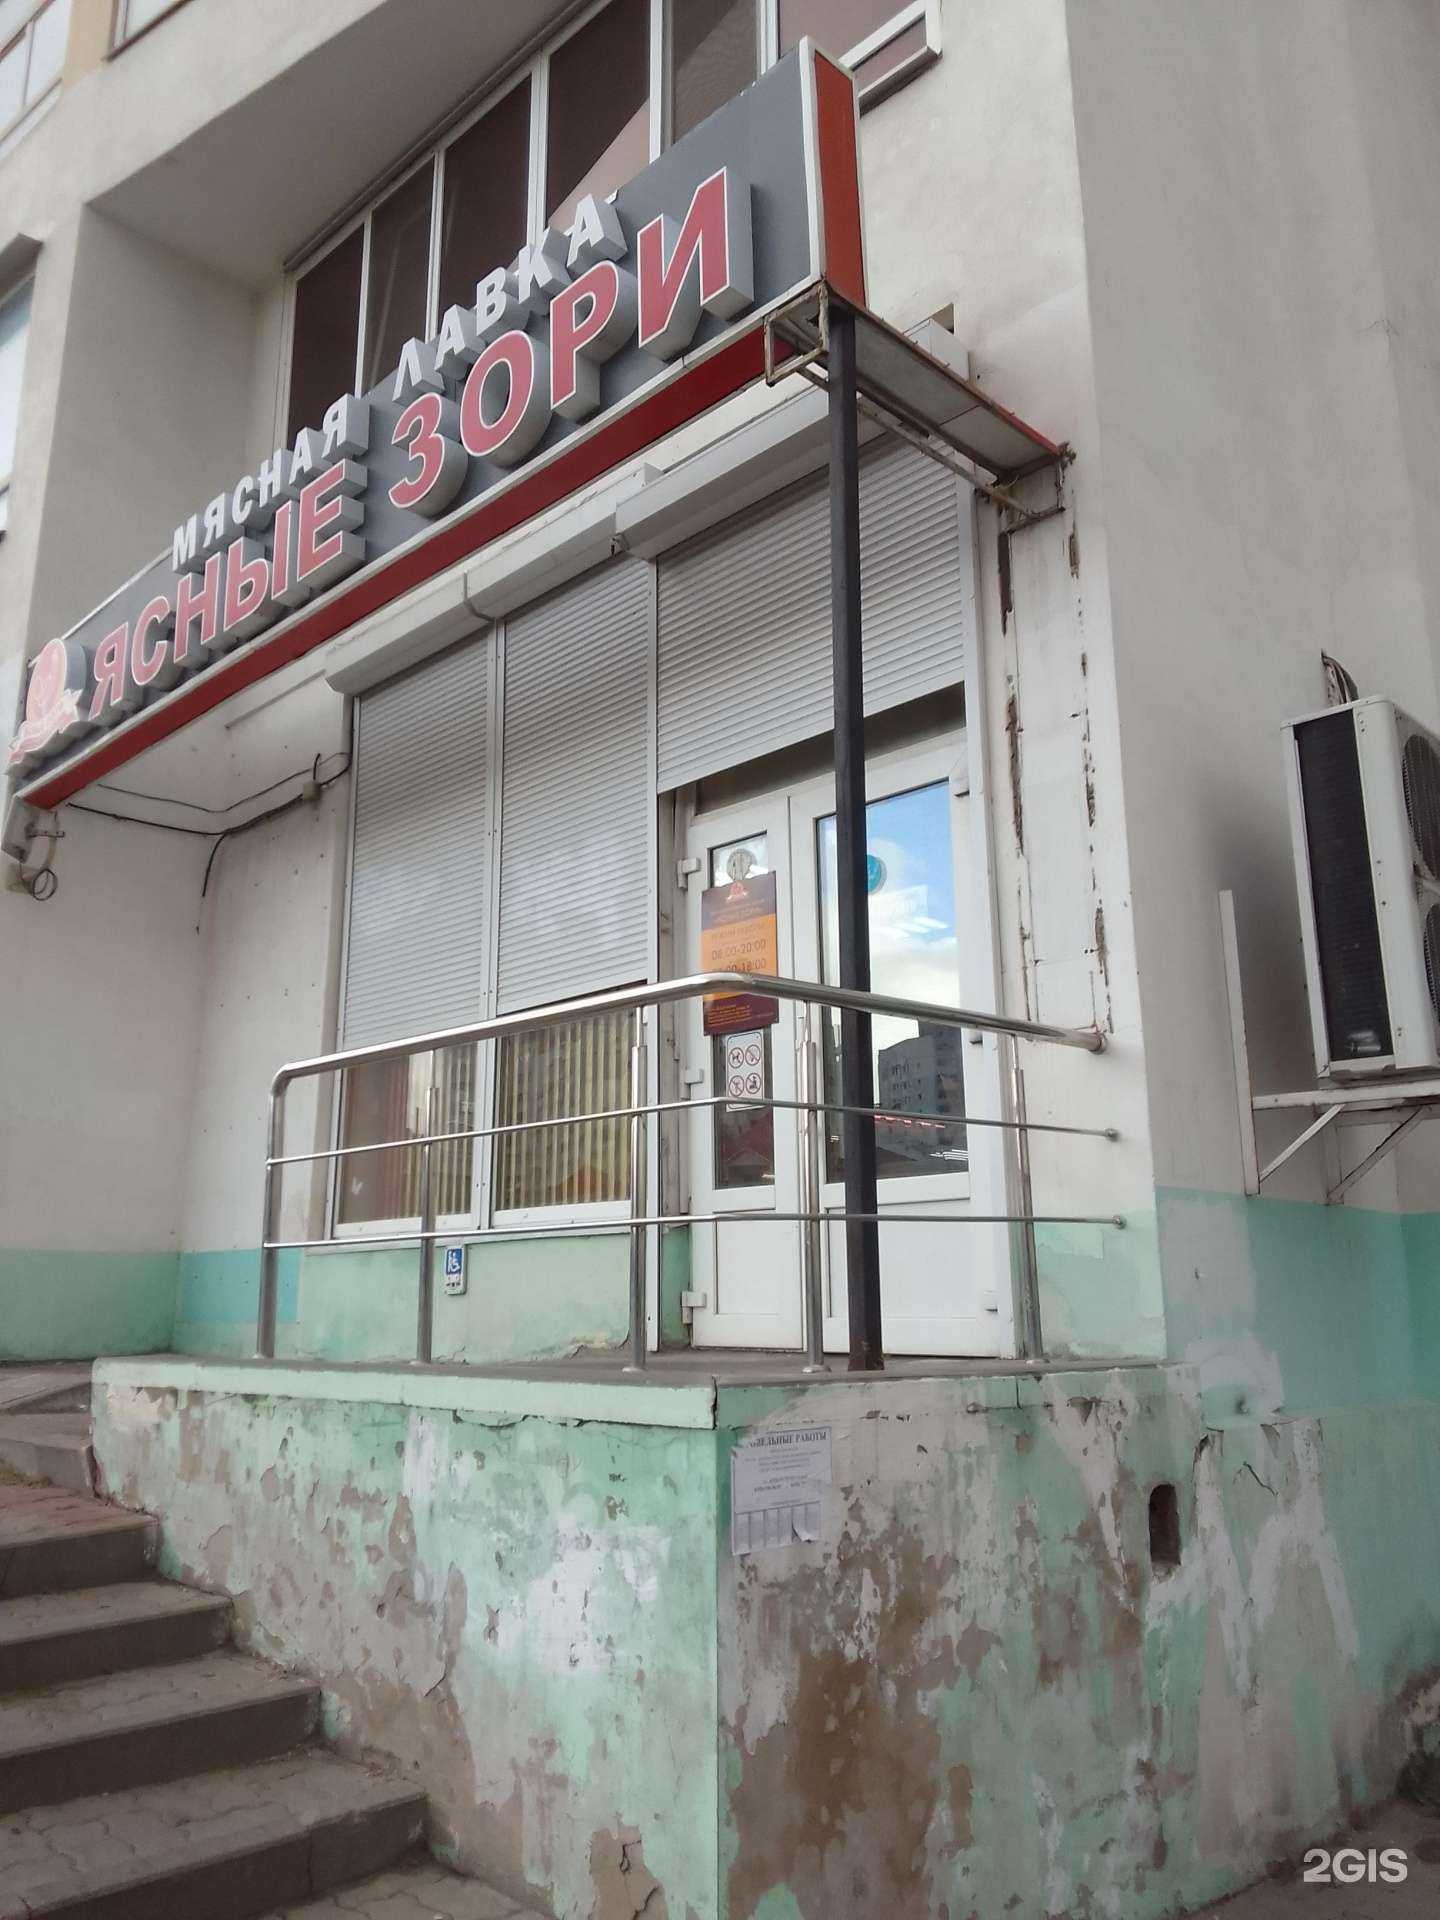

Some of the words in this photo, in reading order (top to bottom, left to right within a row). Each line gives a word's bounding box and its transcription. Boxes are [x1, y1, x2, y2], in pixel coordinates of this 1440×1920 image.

[88, 458, 347, 722] ЯСНЫЕ
[388, 166, 730, 508] ЗОРИ
[172, 393, 349, 572] МЯСНАЯ
[392, 194, 606, 402] ЛАВКА
